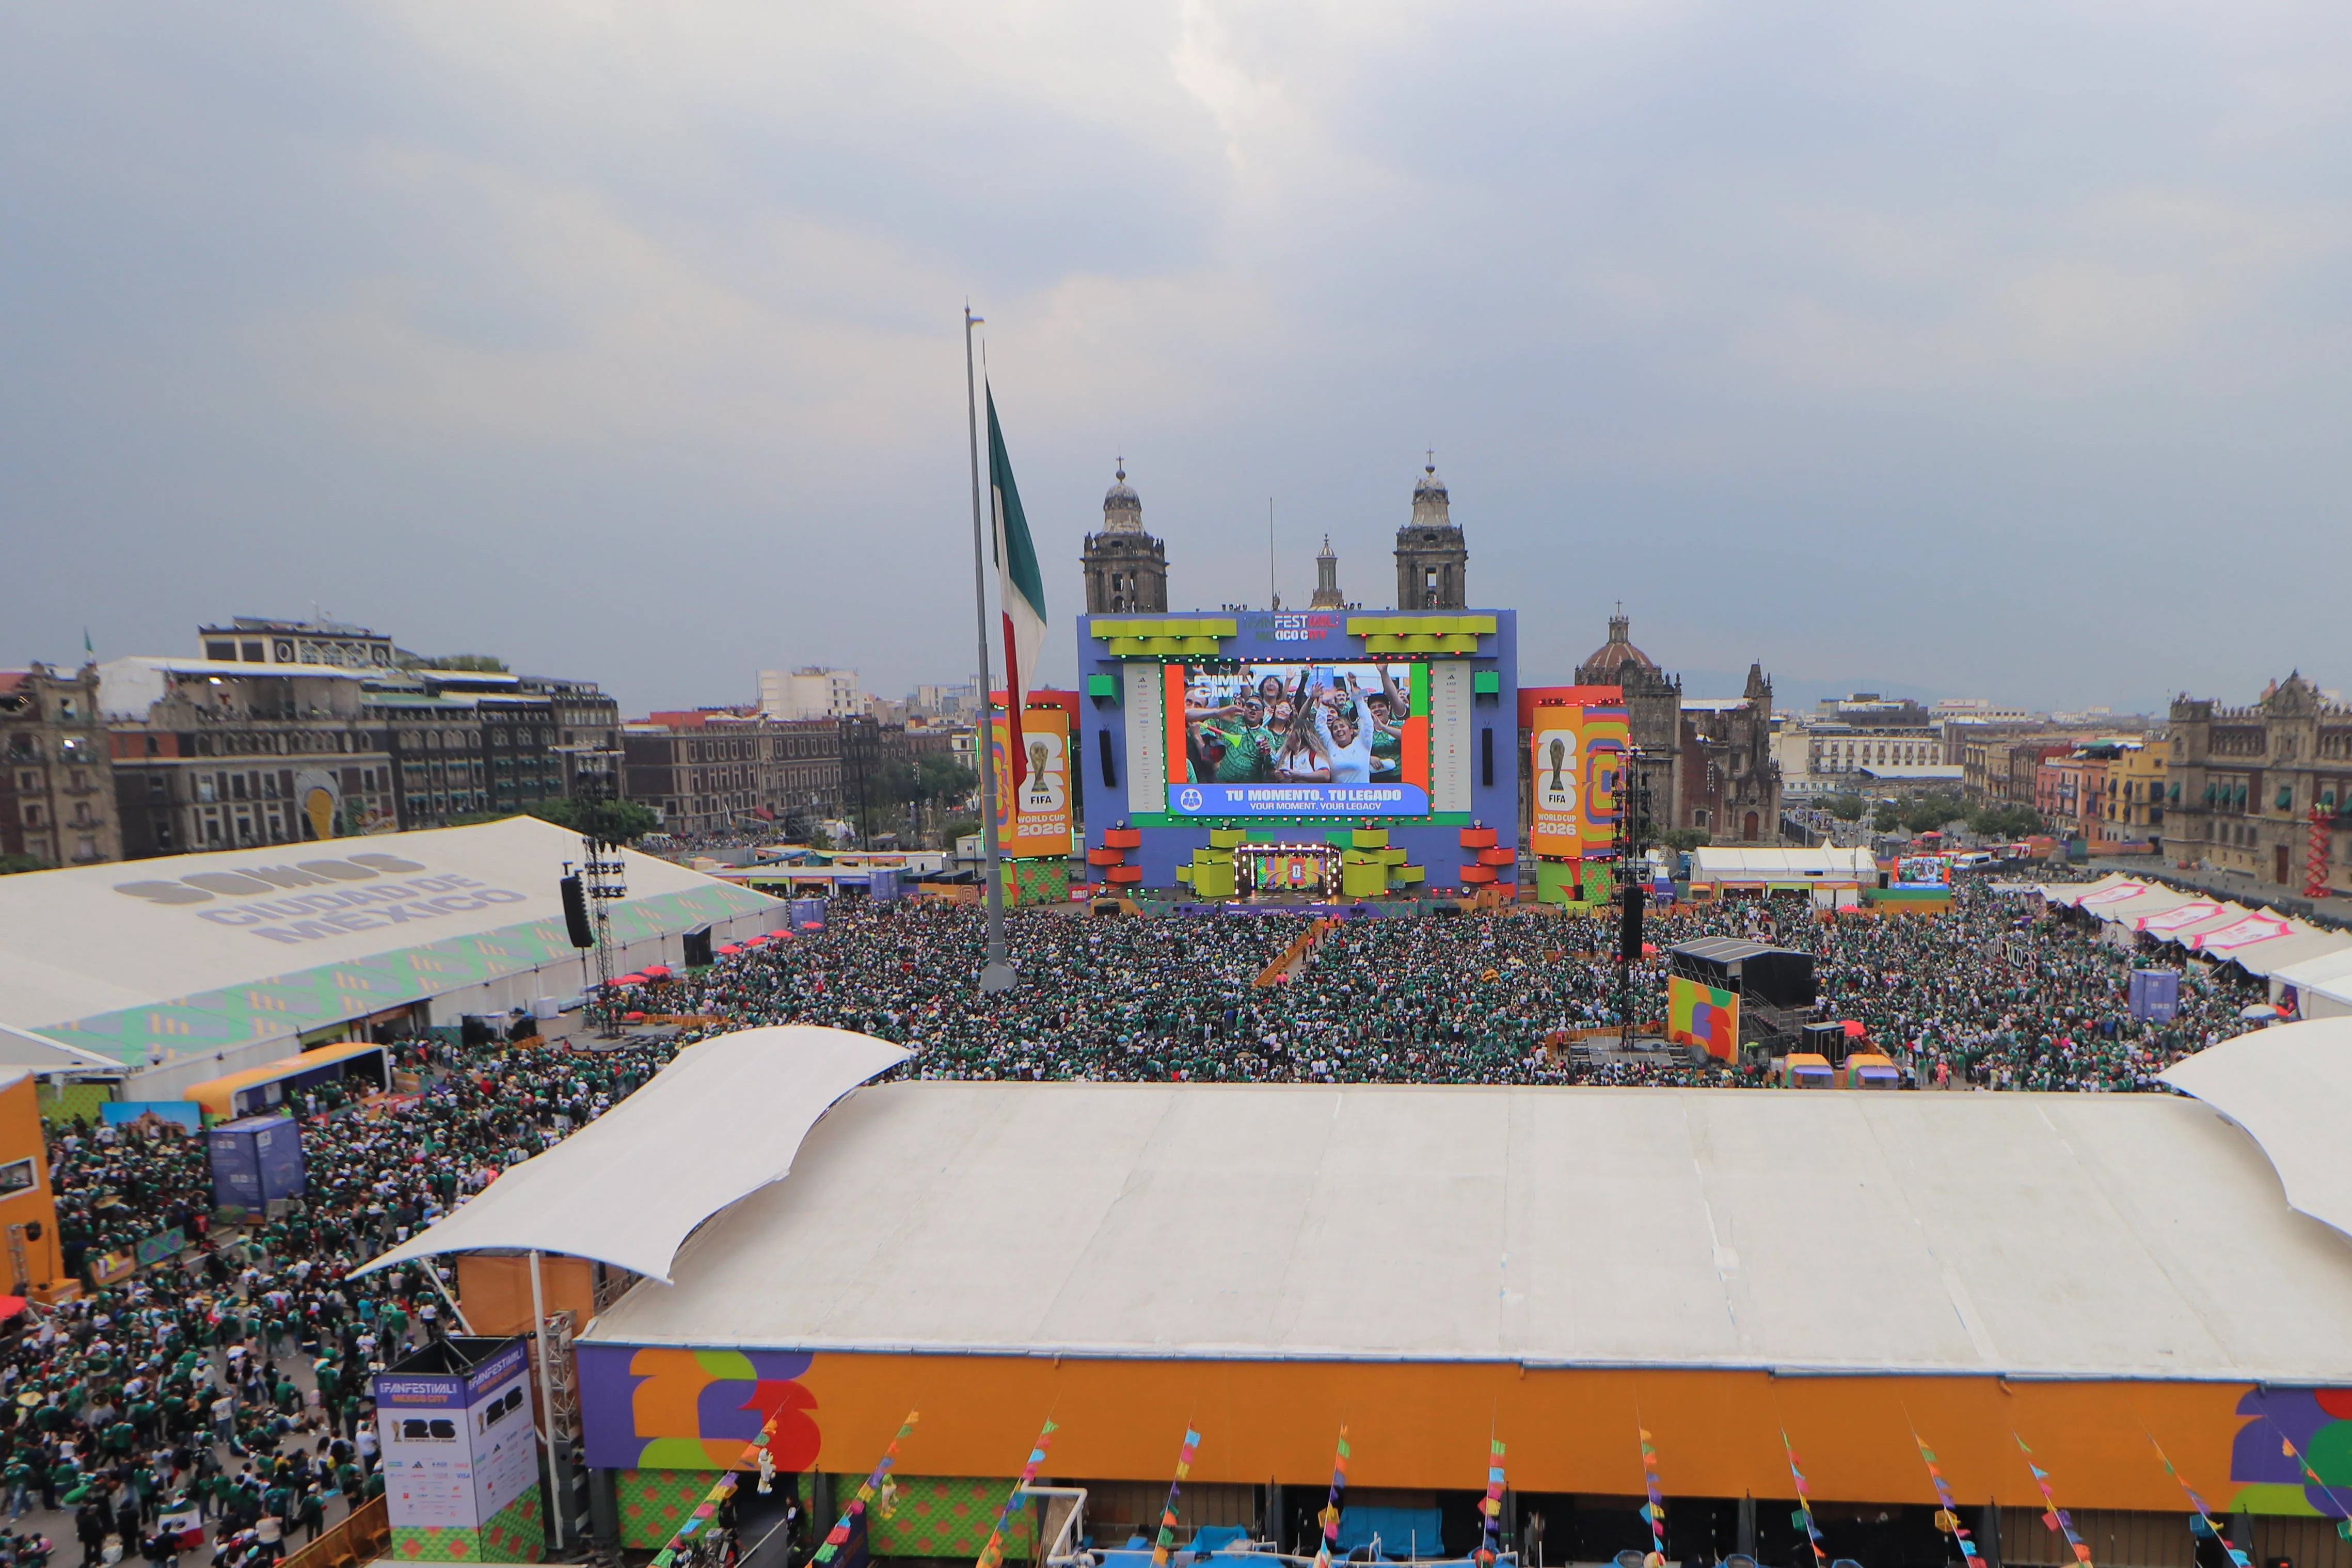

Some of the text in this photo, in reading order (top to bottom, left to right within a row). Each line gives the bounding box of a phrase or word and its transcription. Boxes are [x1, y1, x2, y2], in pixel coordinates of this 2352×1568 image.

[1194, 675, 1256, 686] FAMILY
[1194, 686, 1233, 697] CAM
[1030, 795, 1052, 804] FIFA
[1226, 790, 1402, 801] TU MOMENTO. TU LEGADO
[1549, 795, 1566, 803] FIFA
[1276, 802, 1318, 810] MOMENT.
[1346, 802, 1381, 810] LEGACY
[1018, 814, 1066, 824] WORLD CUP
[1018, 822, 1066, 837] 2026
[1538, 822, 1577, 836] 2026
[112, 853, 426, 905] SOMOS
[196, 873, 486, 925] CIUDAD DE
[249, 889, 528, 944] MÉXICO
